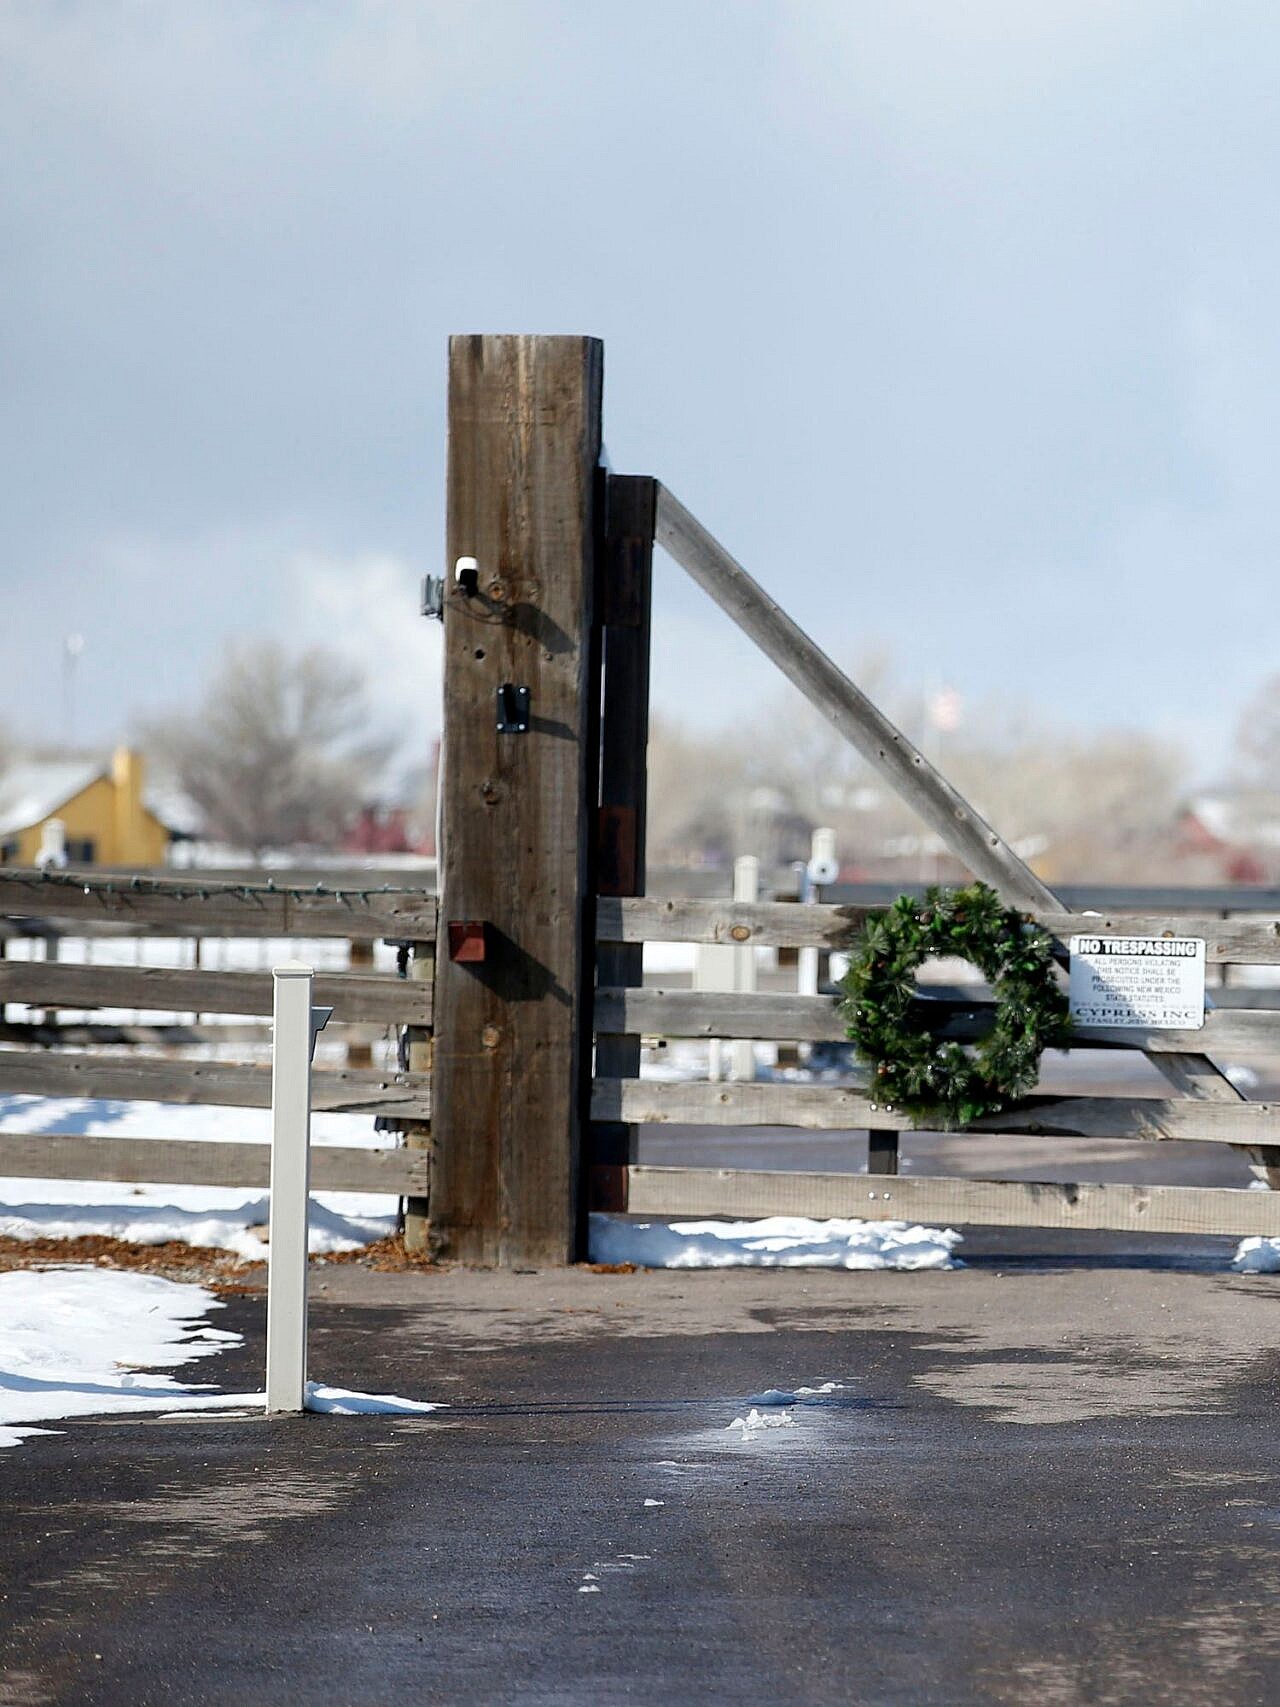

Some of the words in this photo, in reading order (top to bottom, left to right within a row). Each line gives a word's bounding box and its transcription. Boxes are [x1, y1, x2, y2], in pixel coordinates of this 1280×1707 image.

[1081, 940, 1100, 954] NO
[1103, 941, 1195, 956] TRESPASSING
[1076, 1008, 1156, 1017] CYPRESS
[1163, 1010, 1196, 1018] INC
